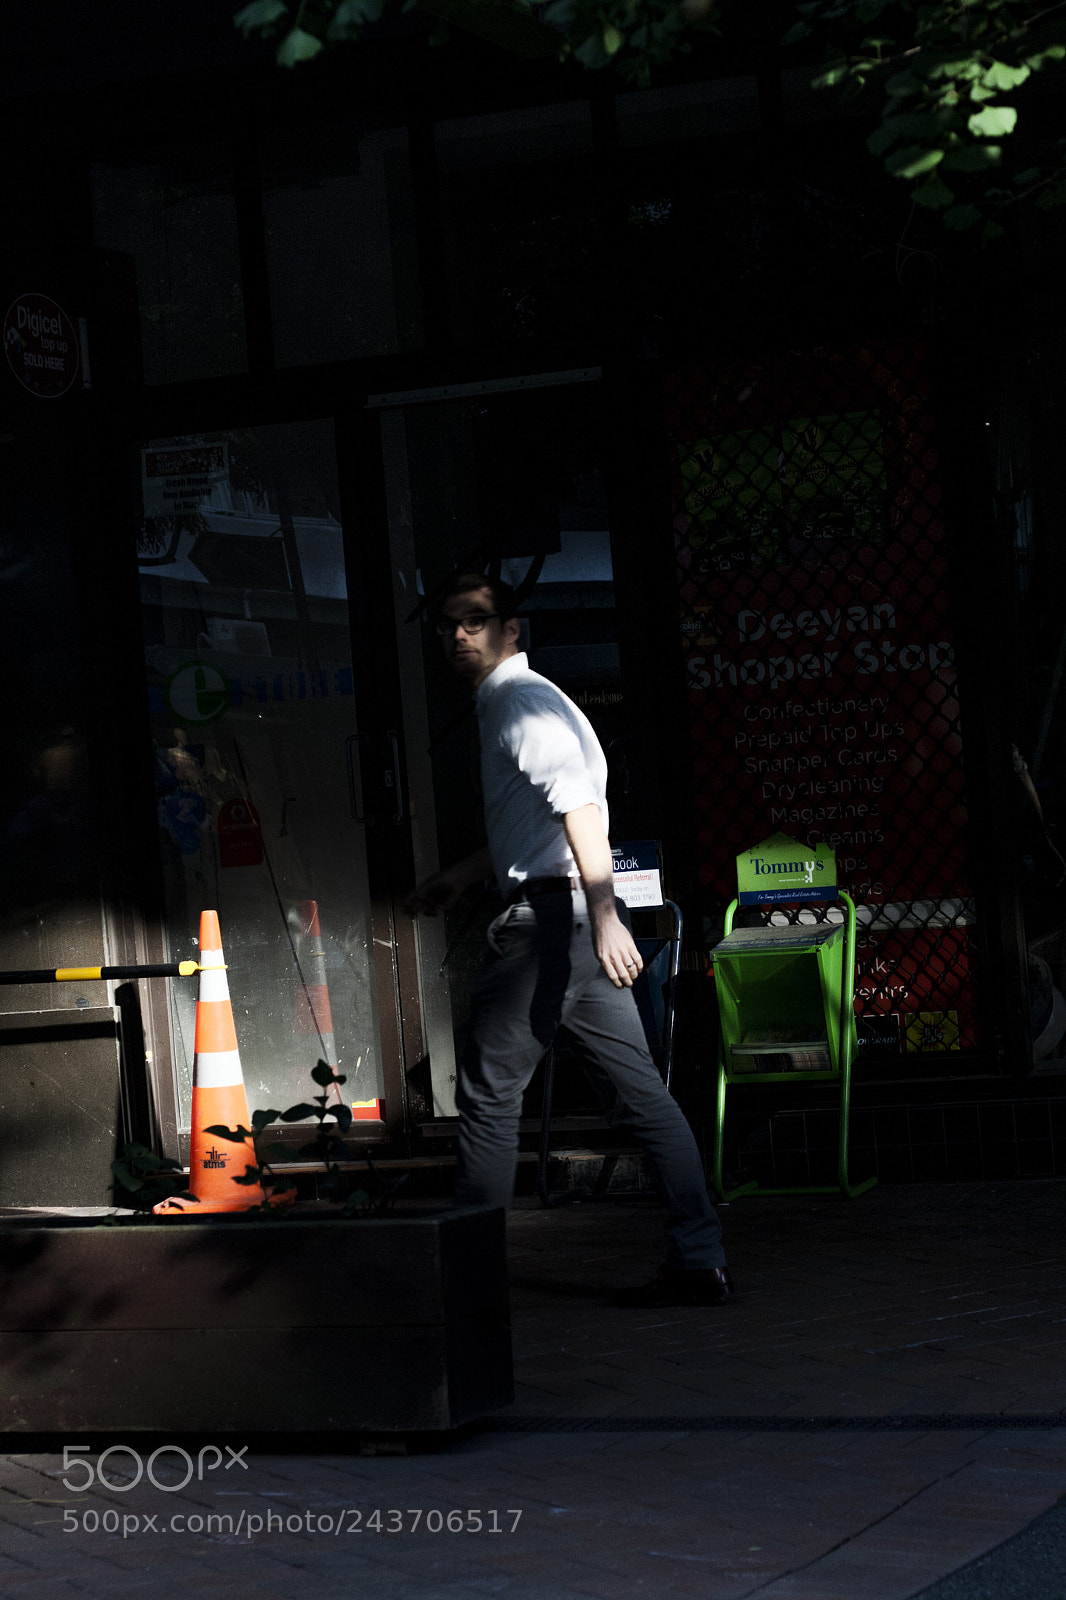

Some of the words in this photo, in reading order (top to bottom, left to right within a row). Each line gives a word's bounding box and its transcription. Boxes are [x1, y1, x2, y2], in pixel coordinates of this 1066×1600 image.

[16, 305, 63, 338] Digicel
[41, 335, 55, 352] top
[57, 341, 68, 354] up
[23, 352, 43, 367] SOLD
[45, 355, 65, 371] HERE
[737, 602, 896, 643] Deeyan
[688, 652, 839, 690] Shoper
[854, 640, 955, 674] Stop
[743, 696, 889, 721] Confectionery
[734, 725, 812, 749] Prepaid
[820, 723, 857, 742] Top
[864, 721, 905, 738] Ups
[744, 753, 831, 775] Snapper
[838, 747, 898, 766] Cards
[761, 774, 885, 800] Drycleaning
[770, 801, 879, 825] Magazines
[806, 829, 884, 846] Creams
[203, 1160, 226, 1169] atms
